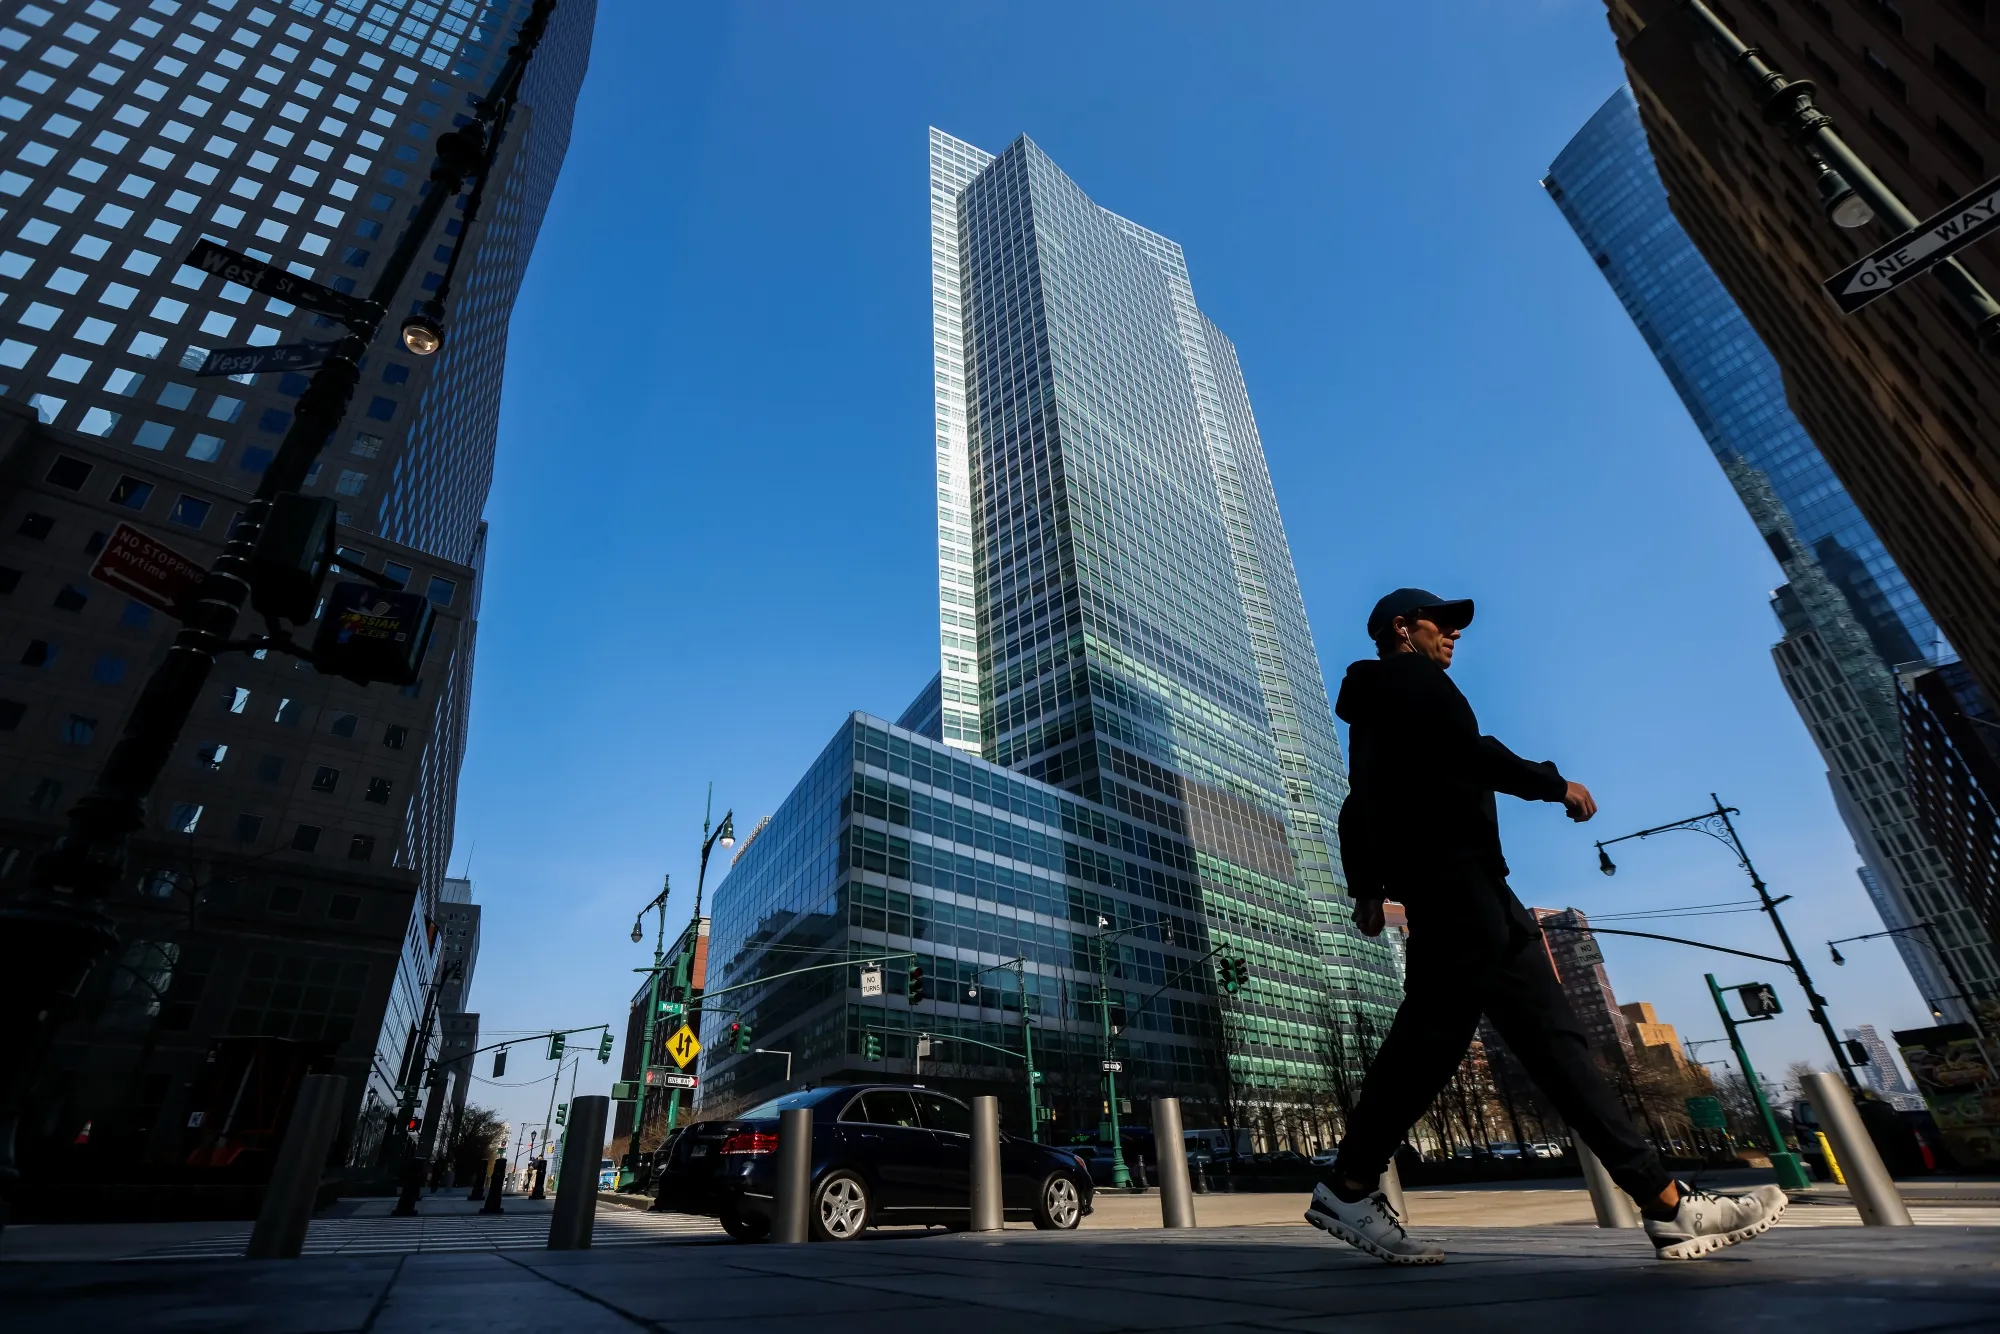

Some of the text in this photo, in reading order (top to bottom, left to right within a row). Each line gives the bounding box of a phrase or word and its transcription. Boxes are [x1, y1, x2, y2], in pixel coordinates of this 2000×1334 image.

[1860, 198, 1995, 286] ONE WAY
[201, 250, 297, 293] West St
[209, 349, 287, 372] Vesey St
[112, 545, 168, 580] Anytime
[120, 530, 205, 584] NO STOPPING
[1578, 953, 1602, 963] TURNS
[1580, 944, 1592, 953] NO
[863, 984, 880, 992] TURNS
